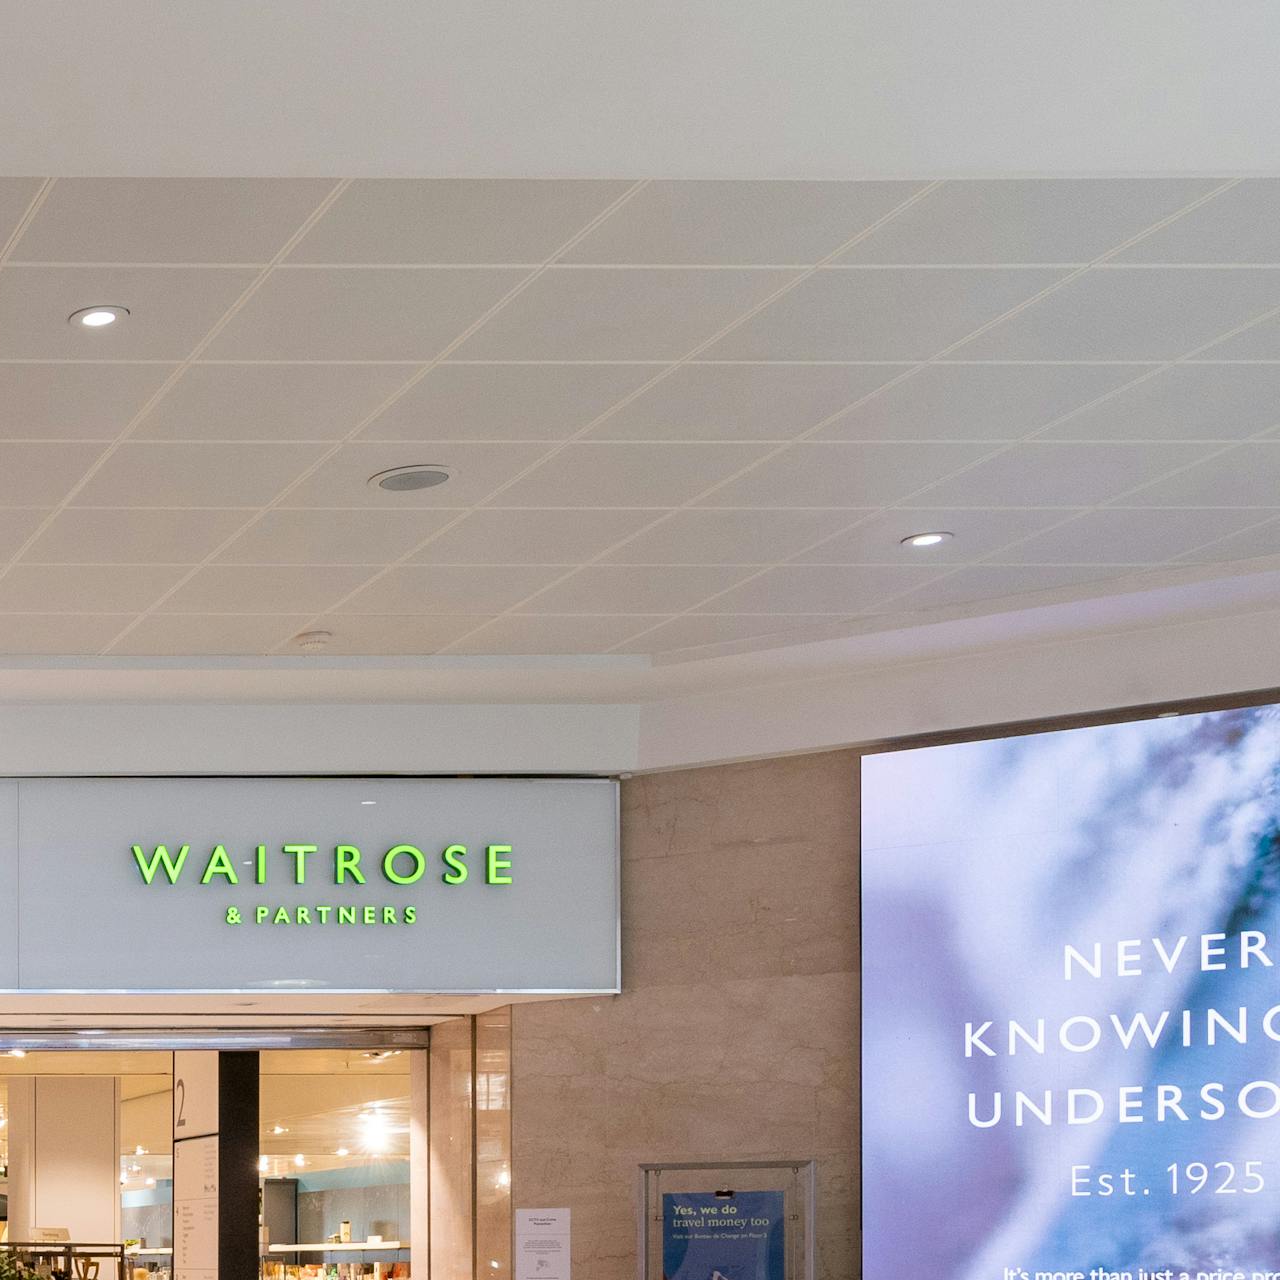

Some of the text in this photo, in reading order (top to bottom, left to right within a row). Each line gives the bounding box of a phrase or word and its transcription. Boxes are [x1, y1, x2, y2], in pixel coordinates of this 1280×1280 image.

[131, 844, 512, 885] WAITROSE
[226, 906, 417, 924] & PARTNERS
[1064, 931, 1273, 980] NEVER
[176, 1079, 186, 1127] 2
[968, 1080, 1280, 1128] UNDERSO
[1071, 1161, 1265, 1196] Est. 1925
[673, 1205, 737, 1216] Yes, we do
[673, 1217, 770, 1229] travel money too
